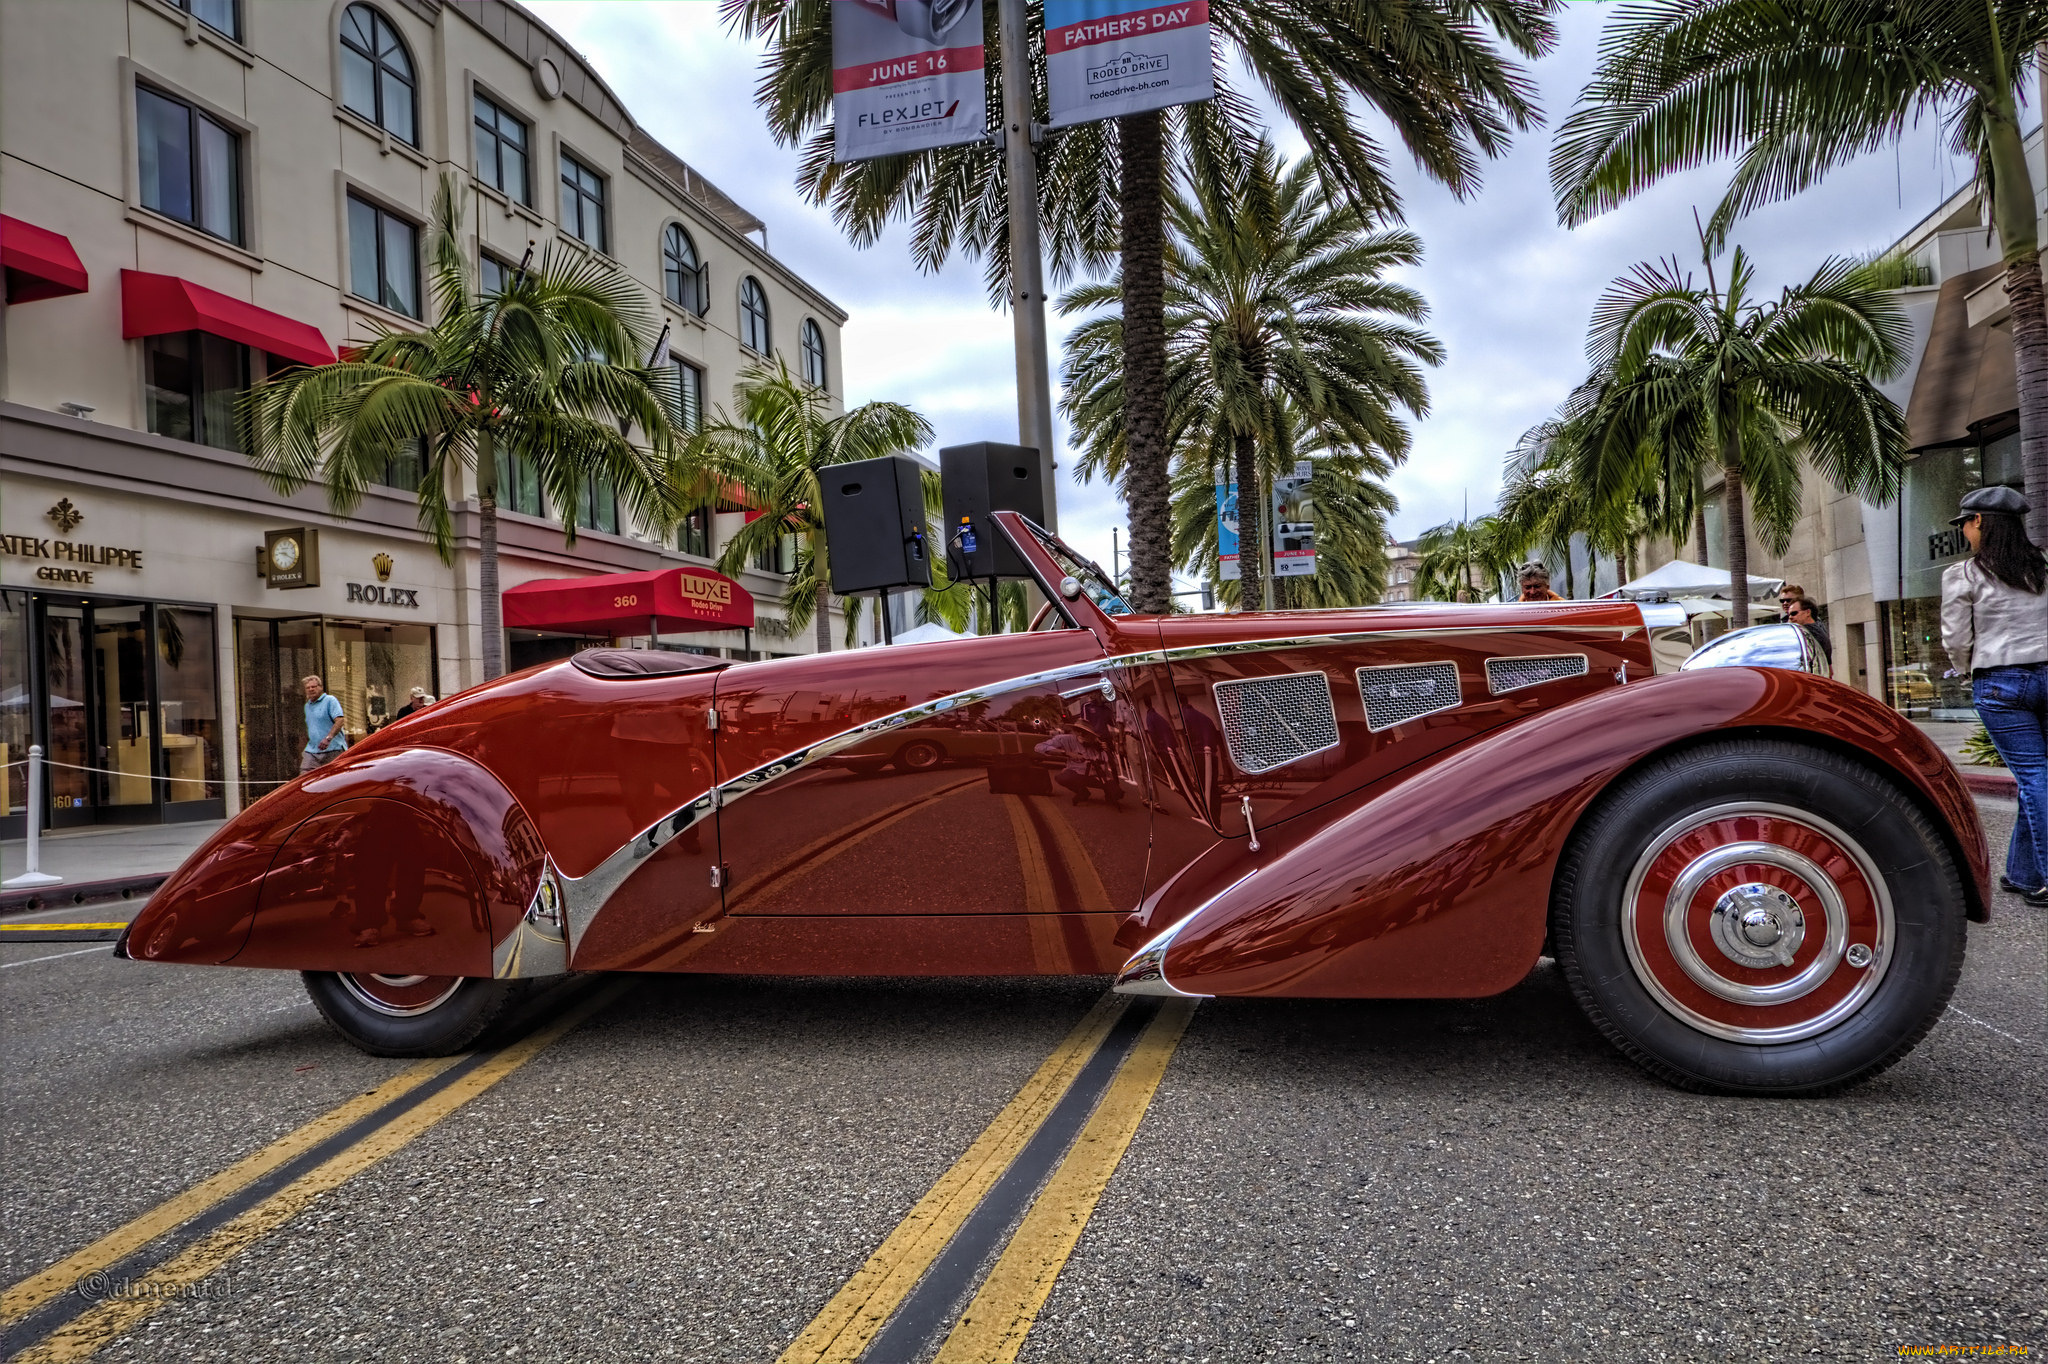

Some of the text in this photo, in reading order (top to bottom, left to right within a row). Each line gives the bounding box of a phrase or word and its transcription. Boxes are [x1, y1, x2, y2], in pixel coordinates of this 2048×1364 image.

[1065, 8, 1190, 45] FATHER'S DAY
[869, 55, 947, 82] JUNE 16
[1093, 59, 1162, 80] RODEO DRIVE
[1090, 80, 1169, 100] rodeodrive-bh.com
[896, 121, 942, 132] BOMBARDIER
[54, 540, 143, 569] PHILIPPE
[1928, 528, 1971, 560] FEND
[37, 566, 94, 584] GENEVE
[346, 582, 419, 607] ROLEX
[684, 578, 729, 599] LUXE
[614, 594, 637, 607] 360
[691, 599, 723, 611] Rodeo Drive
[694, 609, 721, 617] HOTEL
[581, 641, 610, 649] LUXE
[1693, 762, 1809, 783] MICHELIN
